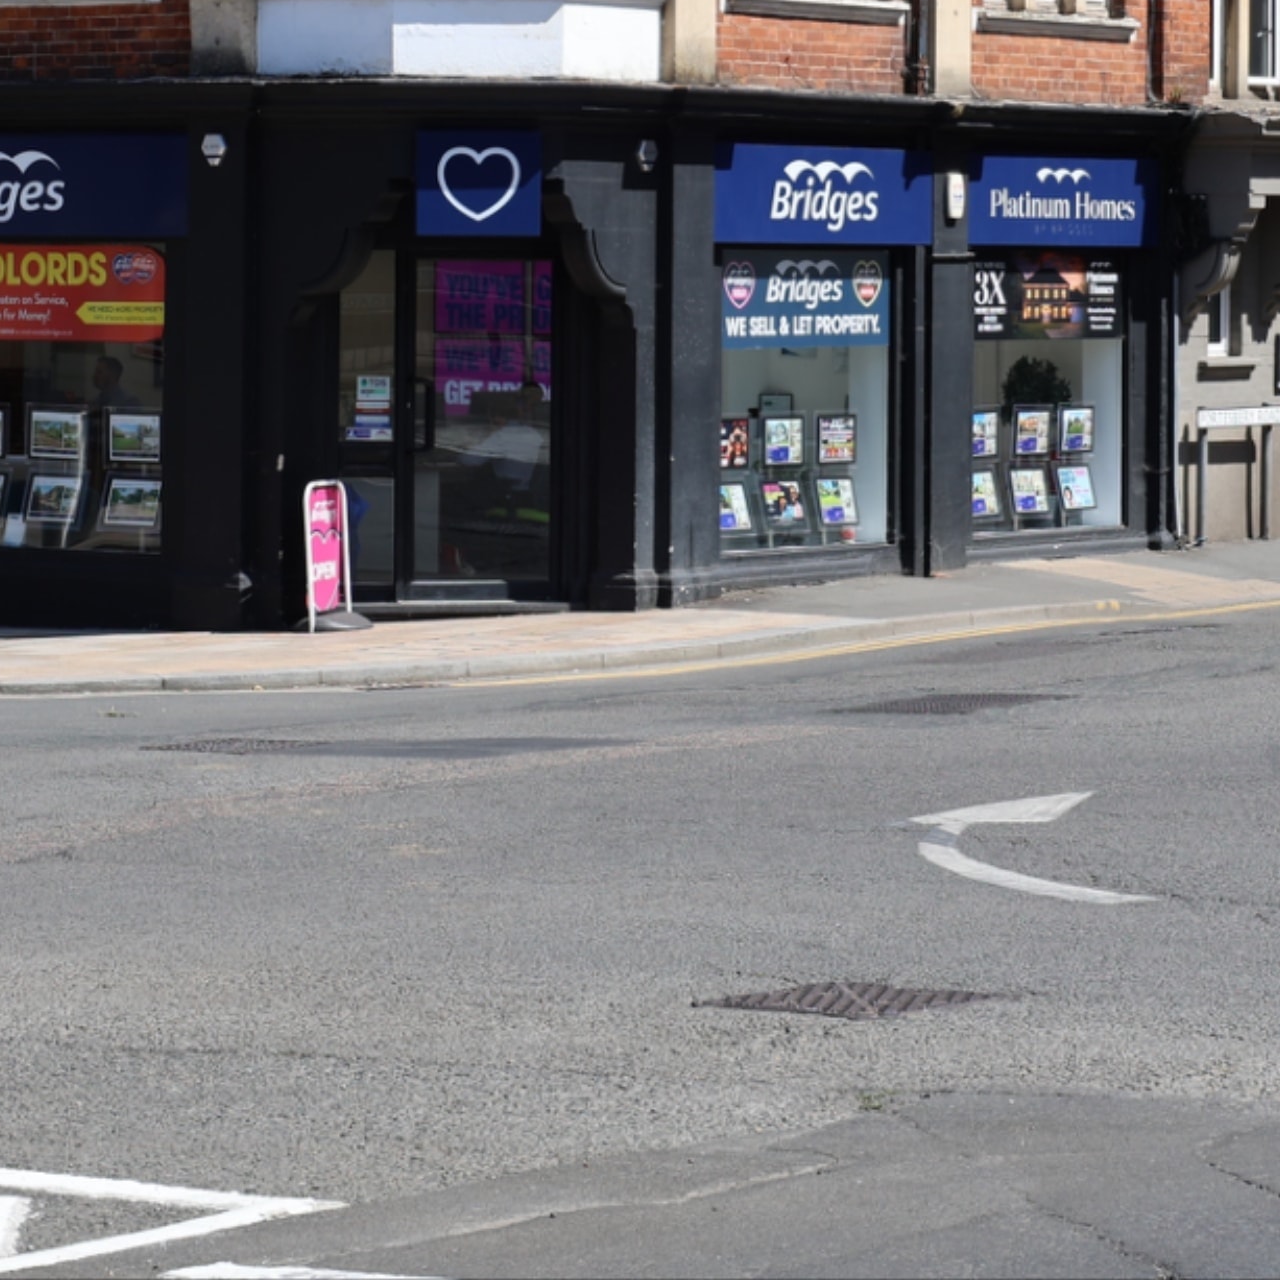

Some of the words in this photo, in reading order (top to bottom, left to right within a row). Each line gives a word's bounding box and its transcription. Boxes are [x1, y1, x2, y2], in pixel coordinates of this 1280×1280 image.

[770, 176, 879, 232] Bridges
[990, 188, 1070, 219] Platinum
[1075, 192, 1136, 221] Homes
[21, 296, 33, 305] on
[445, 274, 525, 301] YOU'VE
[766, 271, 843, 310] Bridges
[974, 271, 1007, 305] 3X
[2, 308, 16, 321] for
[445, 303, 486, 329] THE
[726, 317, 746, 337] WE
[749, 317, 777, 337] SELL
[779, 315, 791, 335] &
[793, 315, 813, 335] LET
[815, 313, 881, 335] PROPERTY.
